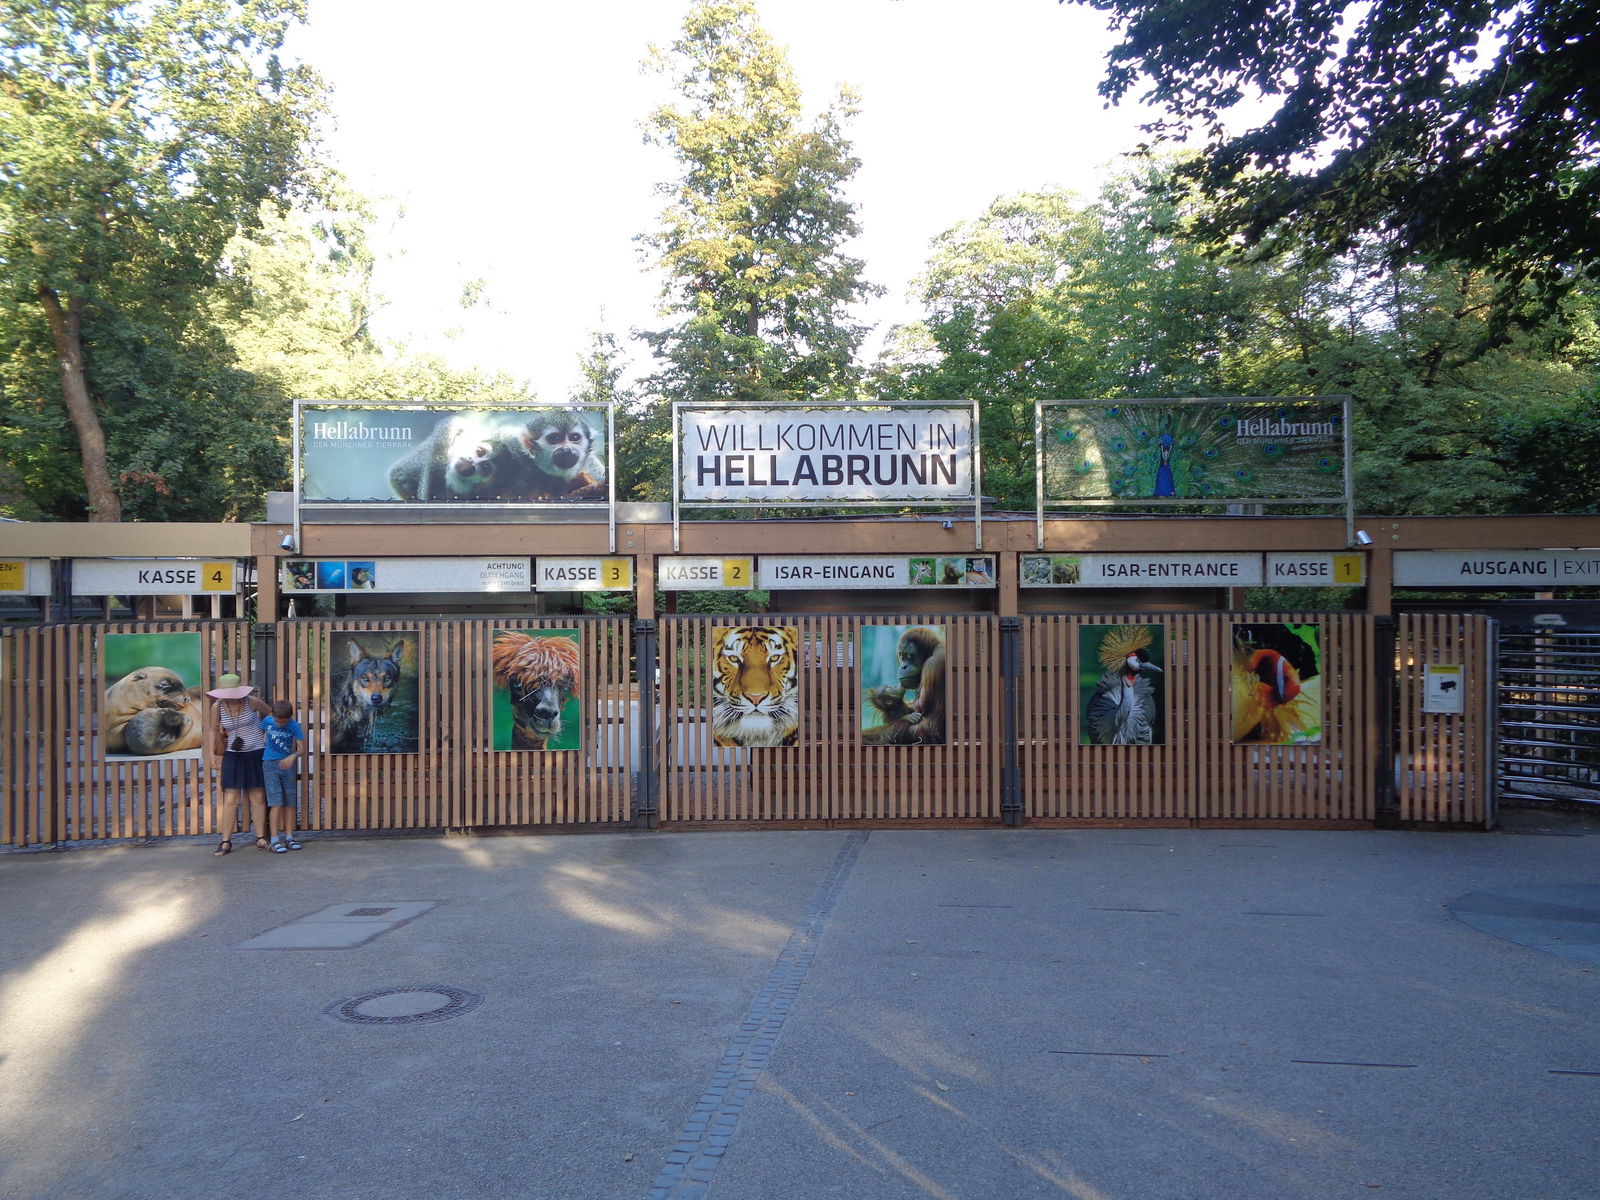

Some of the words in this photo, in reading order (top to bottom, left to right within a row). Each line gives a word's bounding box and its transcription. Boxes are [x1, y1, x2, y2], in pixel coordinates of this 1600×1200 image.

[313, 421, 413, 440] Hellabrunn
[1236, 418, 1334, 436] Hellabrunn
[313, 441, 329, 449] DER
[696, 423, 917, 452] WILLKOMMEN
[929, 423, 956, 451] IN
[697, 453, 957, 487] HELLABRUNN
[486, 562, 525, 570] ACHTUNG!
[544, 567, 597, 580] KASSE
[611, 567, 620, 580] 3
[666, 566, 719, 580] KASSE
[732, 566, 741, 579] 2
[775, 565, 895, 580] ISAR-EINGANG
[1102, 562, 1239, 577] ISAR-ENTRANCE
[1275, 562, 1329, 576] KASSE
[1343, 562, 1351, 576] 1
[1460, 560, 1548, 575] AUSGANG
[1564, 560, 1600, 574] EXIT
[138, 570, 196, 584] KASSE
[211, 570, 223, 584] 4
